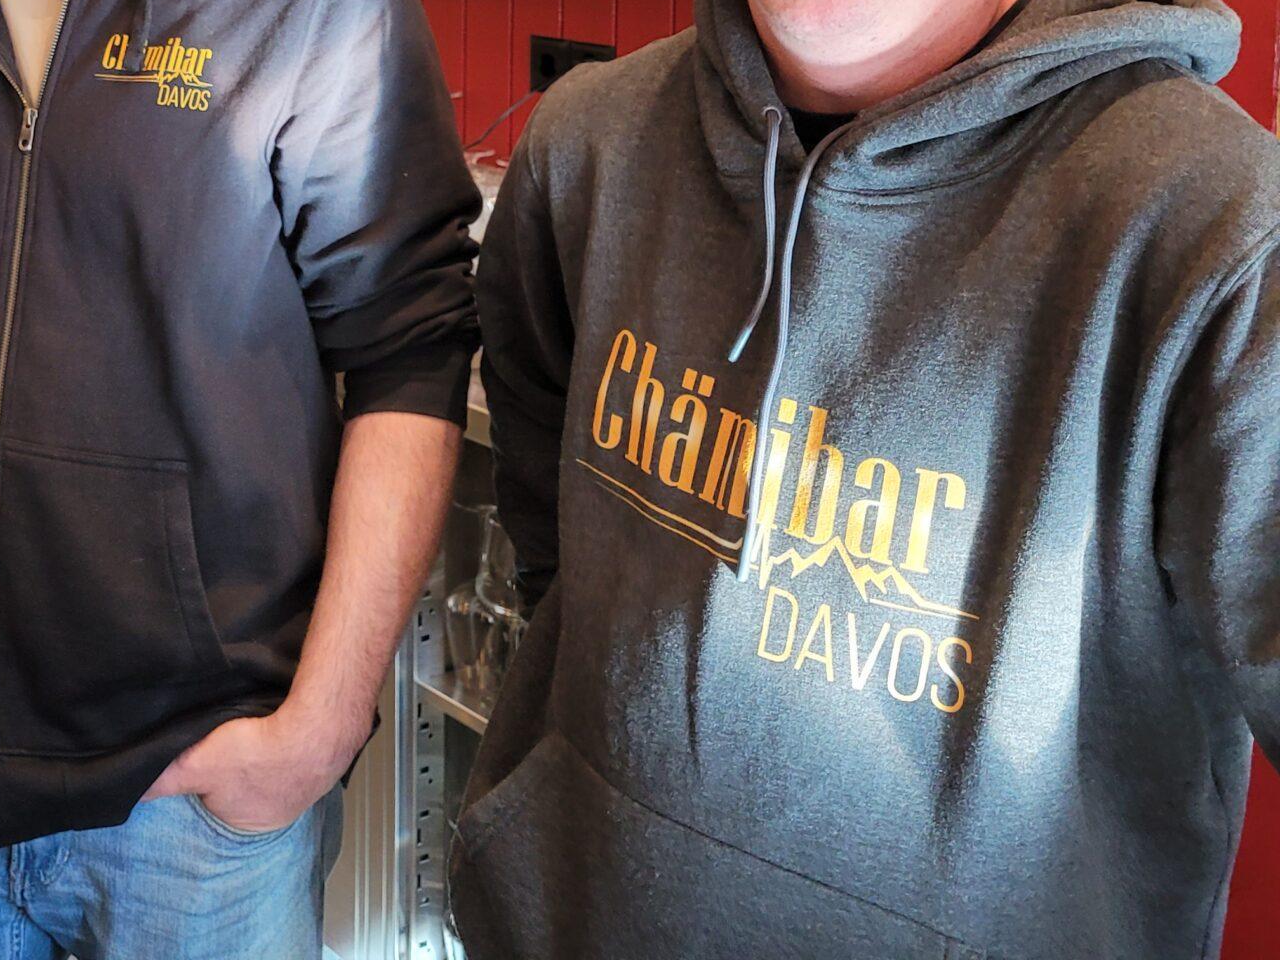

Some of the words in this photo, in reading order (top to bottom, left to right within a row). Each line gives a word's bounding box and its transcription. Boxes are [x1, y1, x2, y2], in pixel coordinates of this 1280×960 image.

[157, 84, 211, 111] DAVOS
[592, 329, 967, 574] Chämibar
[757, 586, 973, 713] DAVOS
